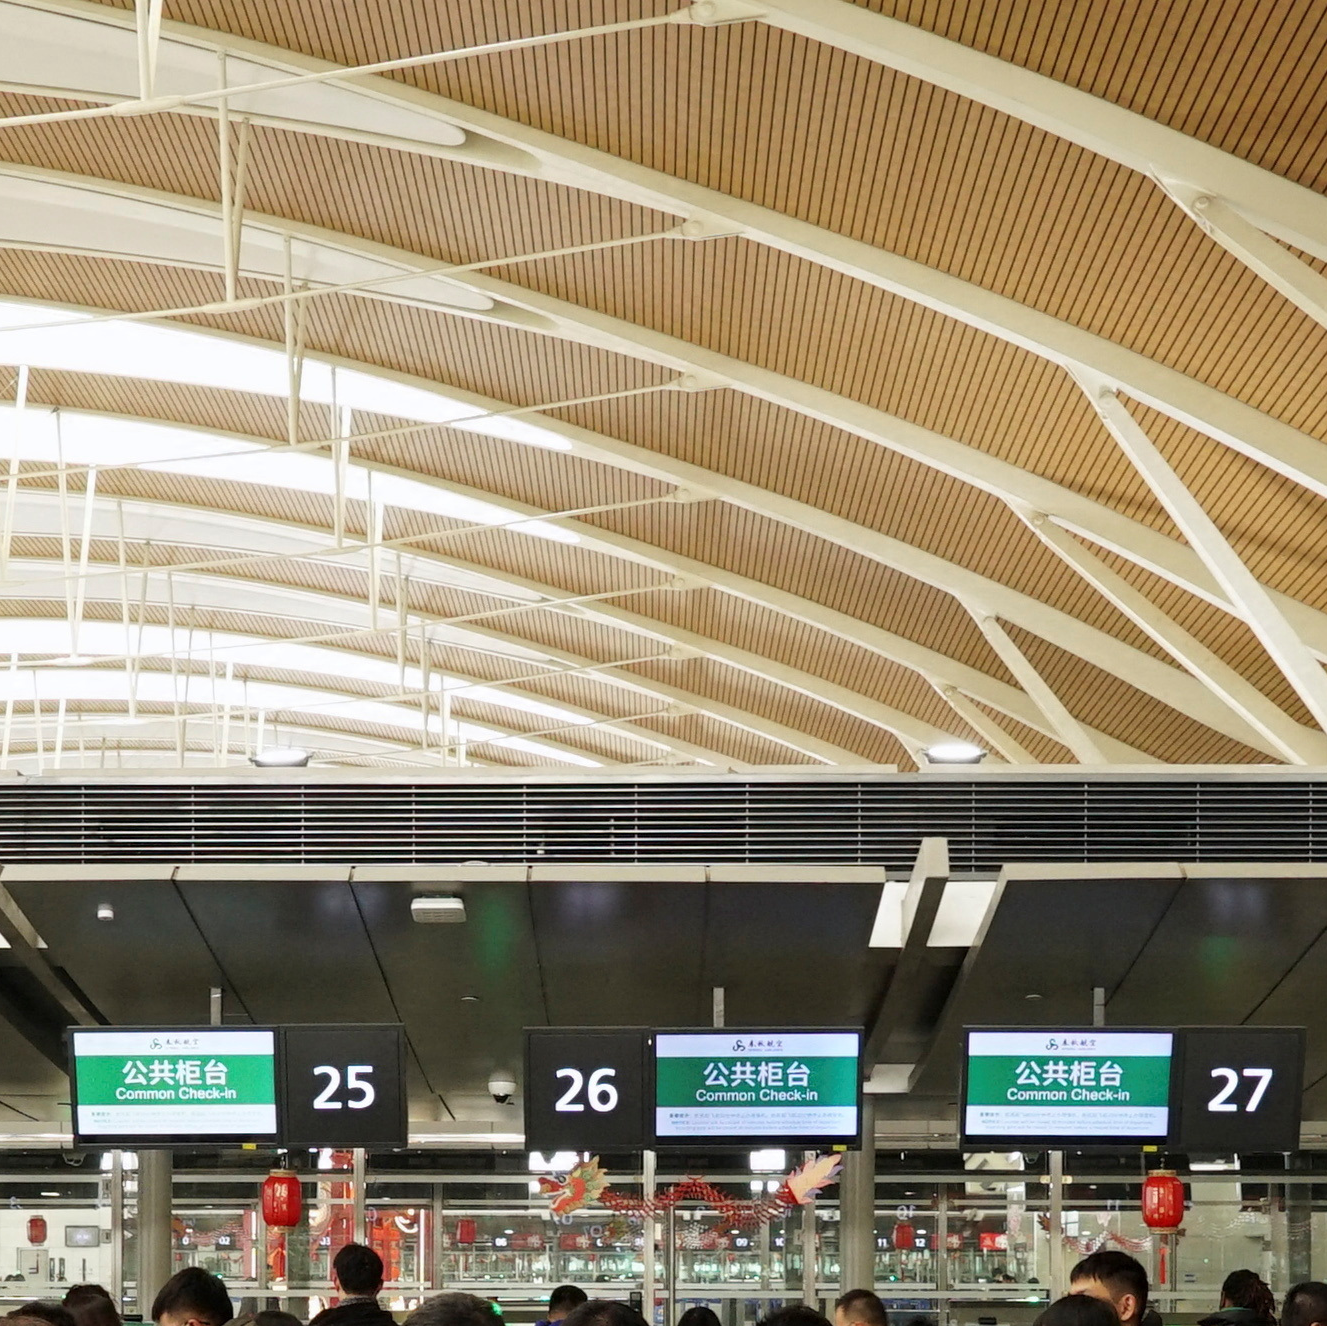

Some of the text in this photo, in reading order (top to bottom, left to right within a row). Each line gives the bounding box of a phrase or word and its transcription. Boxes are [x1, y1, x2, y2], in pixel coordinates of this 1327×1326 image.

[122, 1060, 227, 1085] 公共柜台
[703, 1061, 810, 1087] 公共柜台
[1015, 1061, 1123, 1086] 公共柜台
[116, 1087, 236, 1099] Common Check-in
[313, 1065, 375, 1109] 25
[555, 1068, 618, 1112] 26
[696, 1089, 818, 1101] Common Check-in
[1007, 1088, 1129, 1100] Common Check-in
[1208, 1068, 1272, 1112] 27
